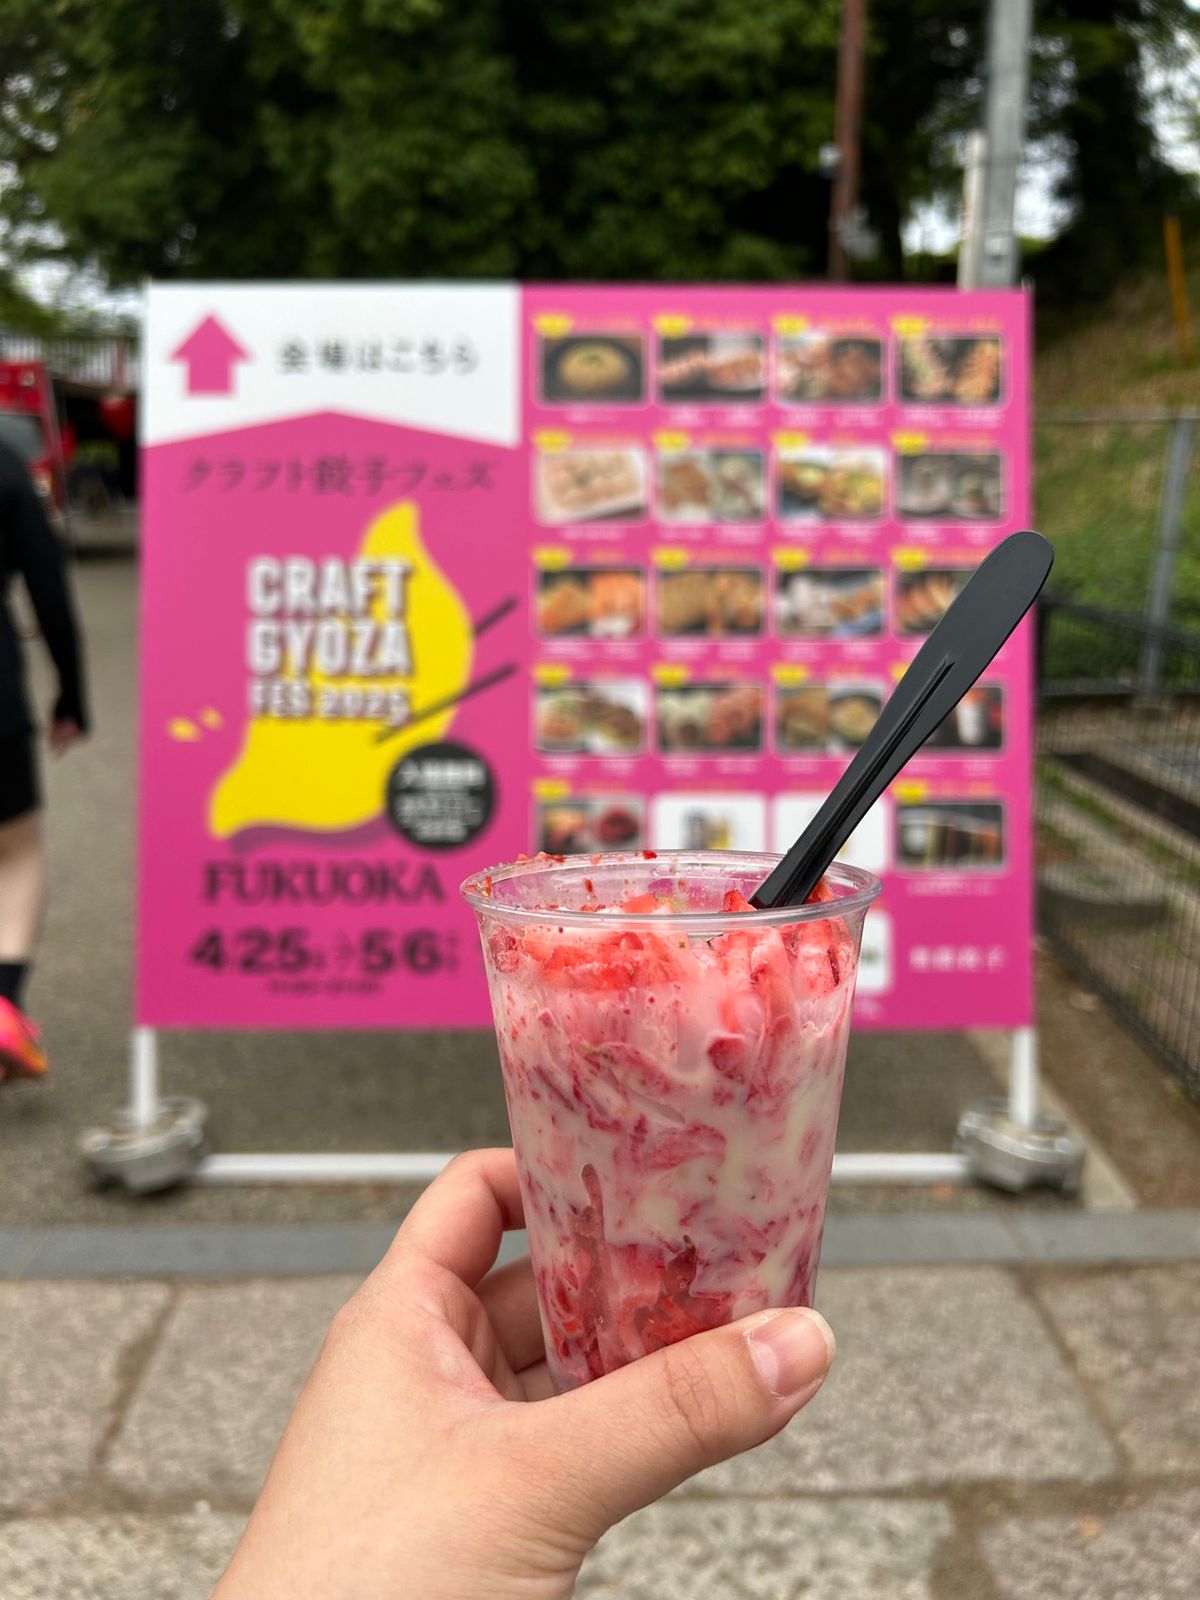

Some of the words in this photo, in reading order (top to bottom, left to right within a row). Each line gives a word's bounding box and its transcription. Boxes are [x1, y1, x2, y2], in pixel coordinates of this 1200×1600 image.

[247, 556, 412, 616] CRAFT
[247, 620, 414, 677] GYOZA
[249, 681, 312, 718] FES
[317, 684, 410, 728] 2025
[203, 861, 446, 907] FUKUOKA
